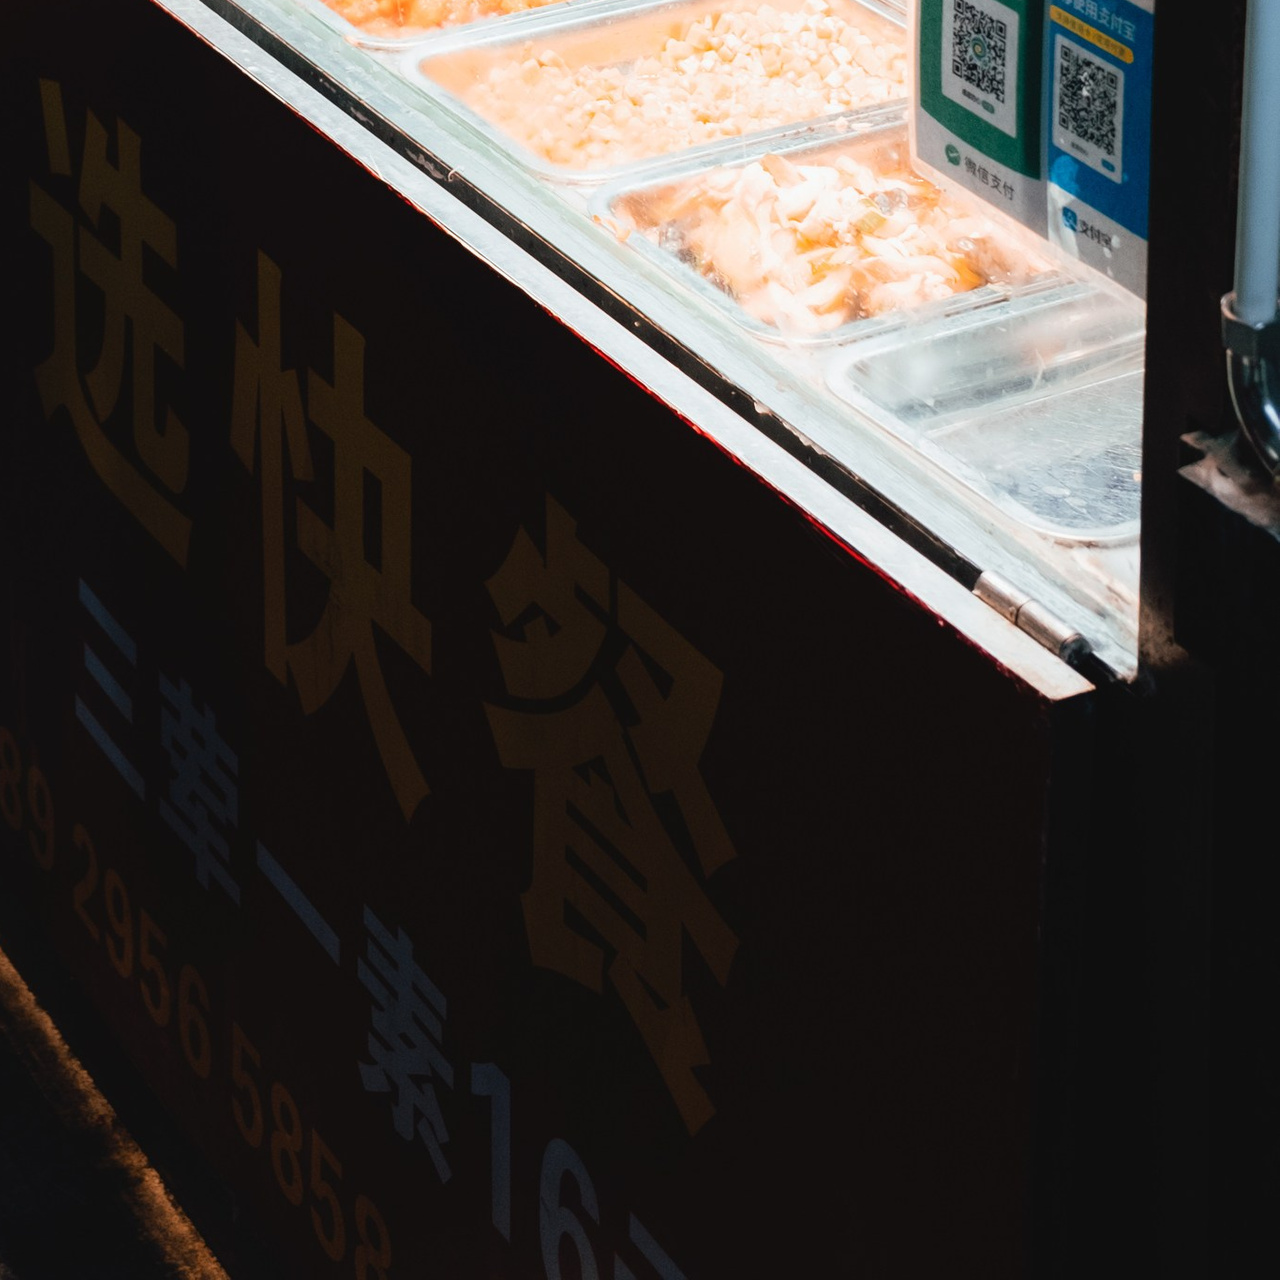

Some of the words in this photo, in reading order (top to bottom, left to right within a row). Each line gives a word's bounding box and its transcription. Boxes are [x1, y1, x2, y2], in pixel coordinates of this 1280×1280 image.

[964, 156, 1015, 201] 微信支付
[1079, 218, 1113, 249] 支付宝
